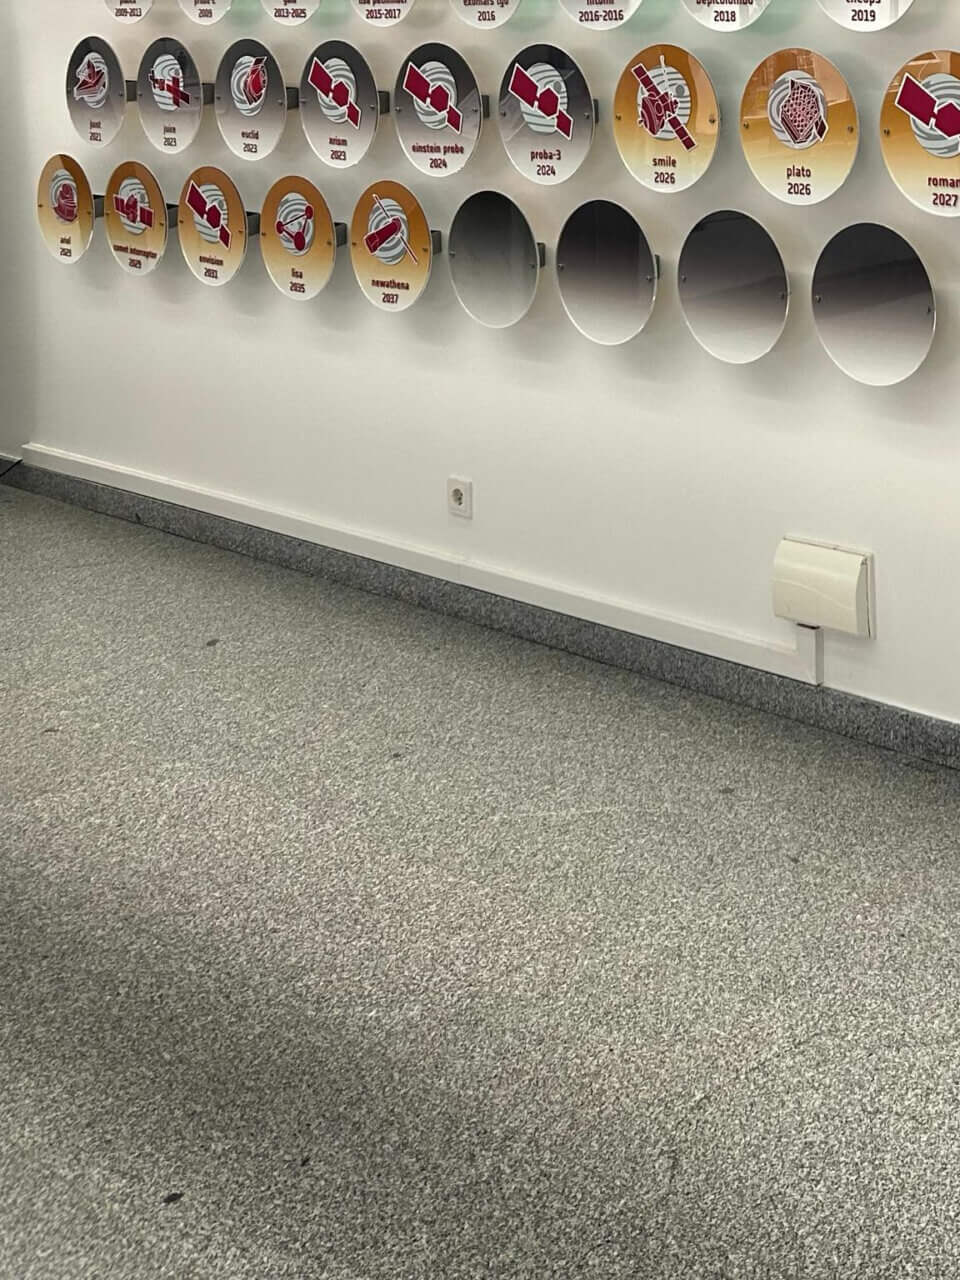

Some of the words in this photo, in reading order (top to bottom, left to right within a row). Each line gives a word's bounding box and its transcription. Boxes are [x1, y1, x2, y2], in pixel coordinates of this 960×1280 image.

[365, 9, 401, 19] 2015-2017
[477, 10, 496, 21] 2016
[578, 10, 624, 22] 2016-2016
[713, 10, 737, 22] 2018
[851, 9, 876, 22] 2019
[412, 143, 441, 154] einstein
[443, 144, 464, 156] probe
[530, 149, 561, 162] proba-3
[429, 158, 447, 169] 2024
[652, 155, 677, 168] smile
[536, 165, 555, 177] 2024
[786, 165, 811, 180] plato
[654, 171, 676, 185] 2026
[787, 183, 811, 196] 2026
[932, 192, 959, 207] 2027
[371, 278, 410, 291] newathena
